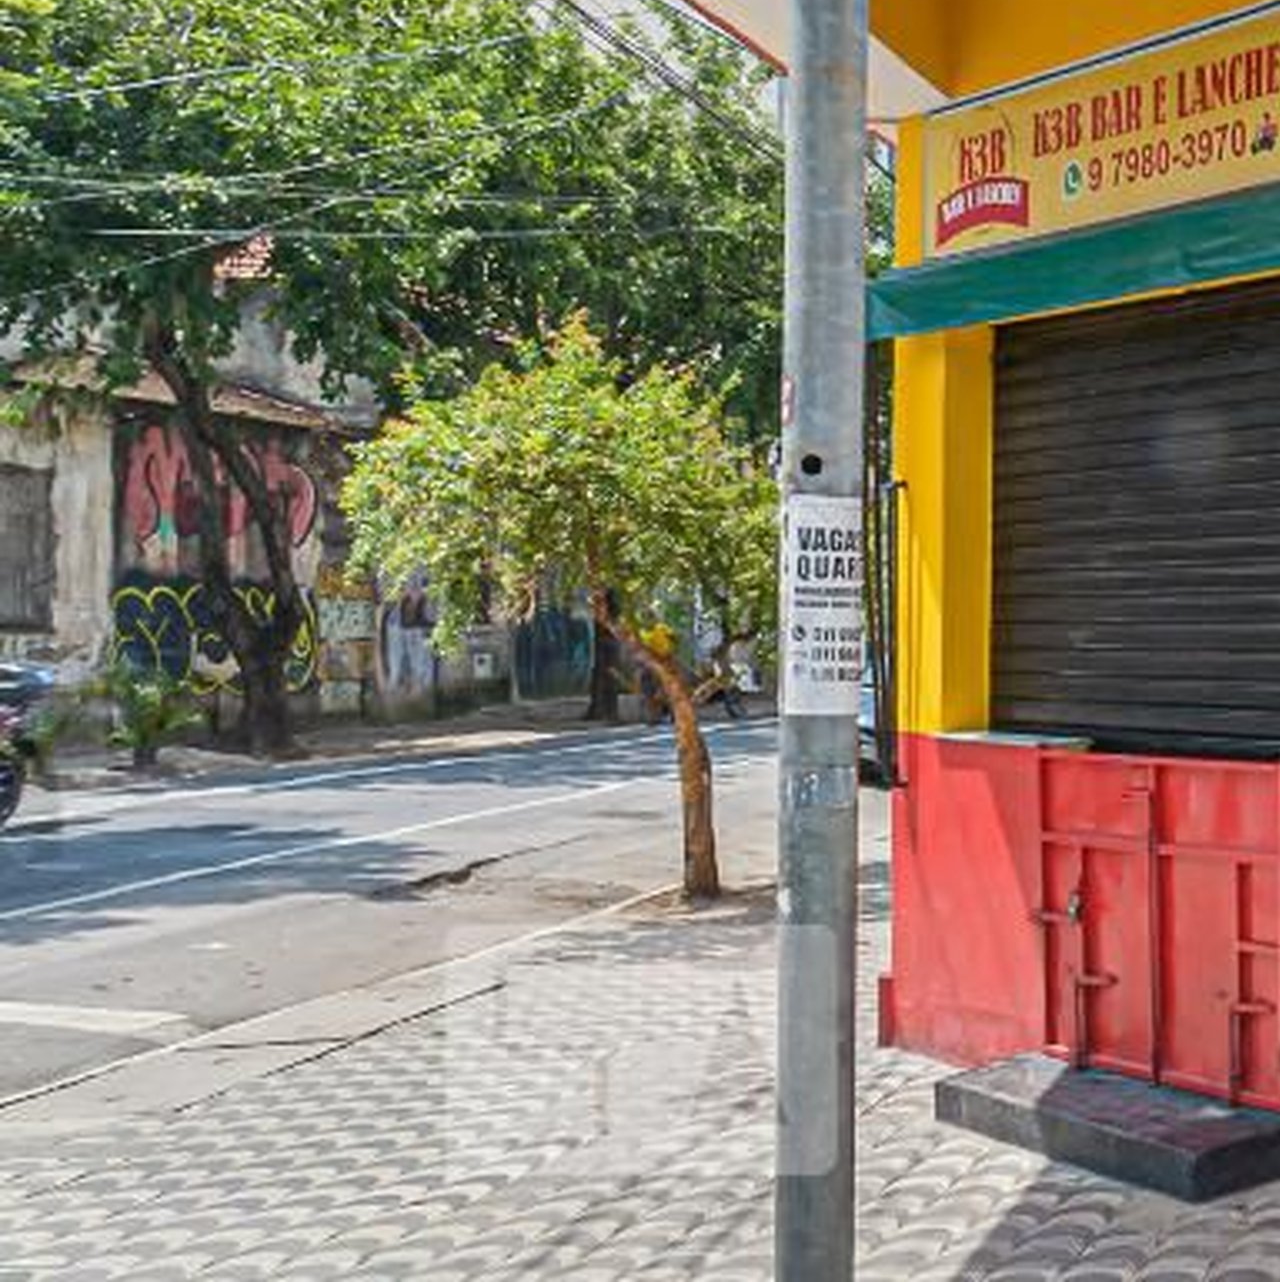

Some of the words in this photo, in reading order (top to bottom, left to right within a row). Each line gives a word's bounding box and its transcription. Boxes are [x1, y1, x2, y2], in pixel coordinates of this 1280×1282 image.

[1033, 101, 1081, 158] K3B
[1090, 84, 1142, 142] BAR
[1153, 75, 1167, 125] E
[960, 129, 1006, 184] K3B
[1087, 157, 1103, 192] 9
[1112, 119, 1246, 187] 7980-3970
